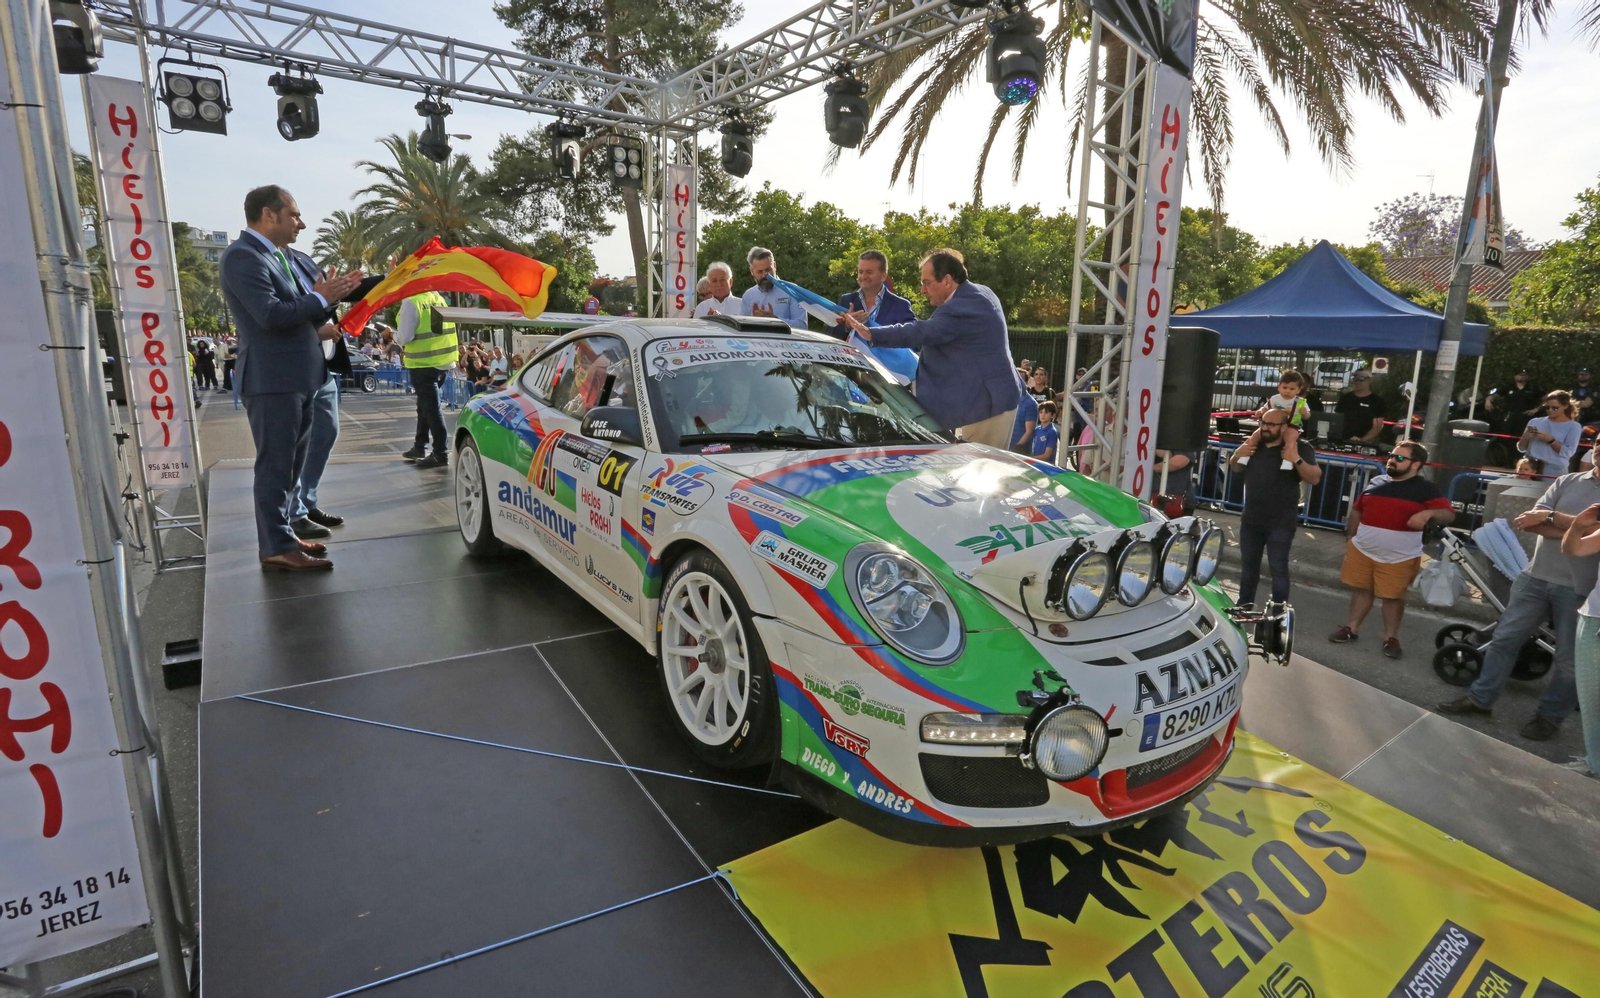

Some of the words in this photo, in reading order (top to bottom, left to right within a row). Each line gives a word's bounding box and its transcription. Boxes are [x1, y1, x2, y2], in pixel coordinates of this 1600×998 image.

[689, 350, 778, 363] AUTOMOVIL
[781, 350, 813, 360] CLUB
[818, 353, 868, 368] ALMERIA
[141, 312, 174, 447] PROHI
[590, 420, 608, 429] JOSE
[592, 429, 621, 438] ANTONIO
[148, 463, 160, 471] 956
[161, 463, 170, 471] 34
[171, 462, 180, 470] 18
[181, 462, 189, 470] 14
[600, 456, 630, 490] 01
[498, 480, 577, 545] andamur
[640, 484, 698, 511] TRANSPORTES
[739, 496, 750, 504] D.
[498, 509, 530, 530] AREAS
[543, 533, 580, 567] SERVICIO
[778, 552, 827, 581] MASHER
[787, 547, 828, 571] GRUPO
[618, 587, 634, 604] TIRE
[804, 672, 830, 687] NACIONAL
[866, 698, 906, 713] INTERNACIONAL
[838, 679, 865, 696] TRANSPORTE
[1133, 637, 1239, 714] AZNAR
[803, 677, 861, 712] TRANS-EURO
[861, 701, 906, 726] SEGURA
[1145, 735, 1154, 744] E
[1162, 700, 1210, 741] 8290
[802, 747, 836, 777] DIEGO
[857, 780, 914, 813] ANDRES
[39, 886, 67, 910] 34
[73, 877, 98, 898] 18
[105, 867, 130, 889] 14
[36, 901, 102, 938] JEREZ
